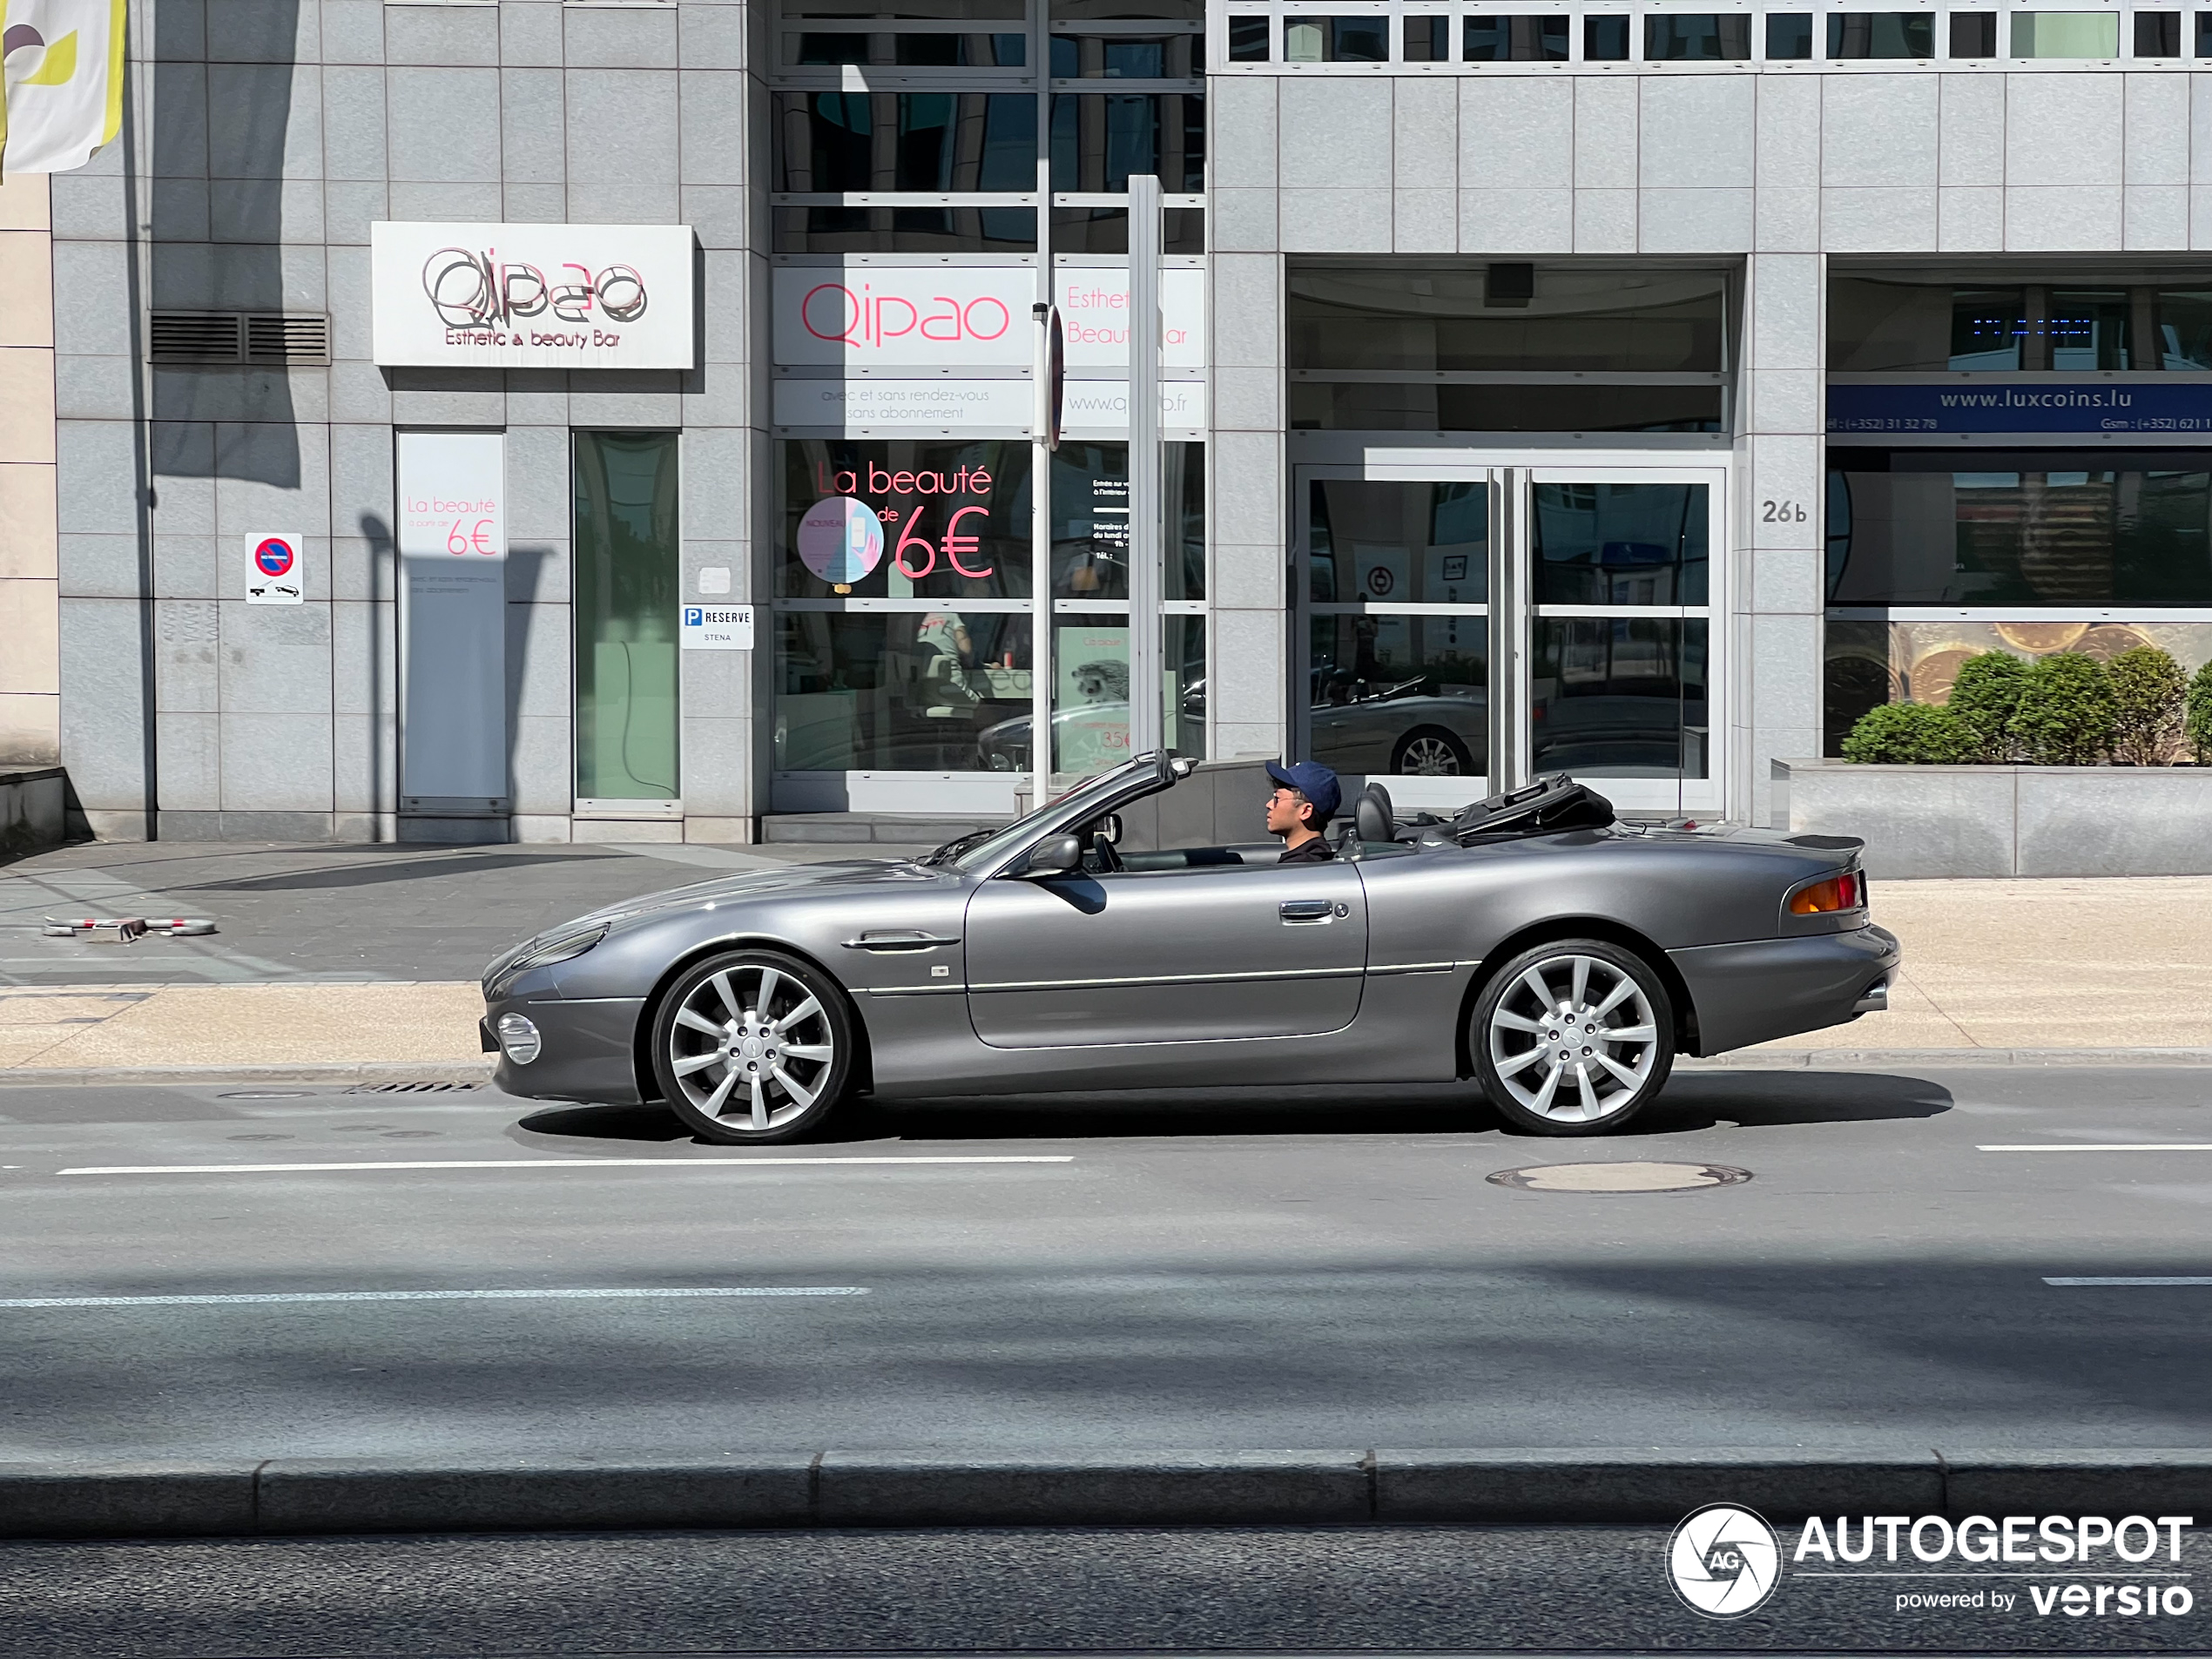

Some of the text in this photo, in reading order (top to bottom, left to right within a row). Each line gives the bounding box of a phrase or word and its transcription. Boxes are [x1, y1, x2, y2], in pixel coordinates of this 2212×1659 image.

[421, 246, 644, 319] Qipao
[1068, 287, 1130, 308] Esthet
[802, 283, 1009, 348] Qipao
[445, 328, 620, 349] Esthetic & beauty Bar
[1068, 321, 1187, 344] Beaut ar
[821, 388, 989, 401] avec et sans rendez-vous
[1069, 394, 1187, 415] www.qo.fr
[1940, 389, 2131, 408] www.luxcoins.lu
[847, 406, 963, 419] sans abonnement
[1886, 419, 1900, 429] 31
[1905, 419, 1919, 429] 32
[1922, 419, 1938, 429] 78
[2101, 418, 2129, 429] Gsm
[2179, 418, 2200, 429] 621
[818, 460, 992, 494] La beauté
[408, 496, 496, 513] La beauté
[448, 519, 496, 556] 6€
[877, 505, 993, 578] de 6€
[687, 610, 750, 625] P RESERVE
